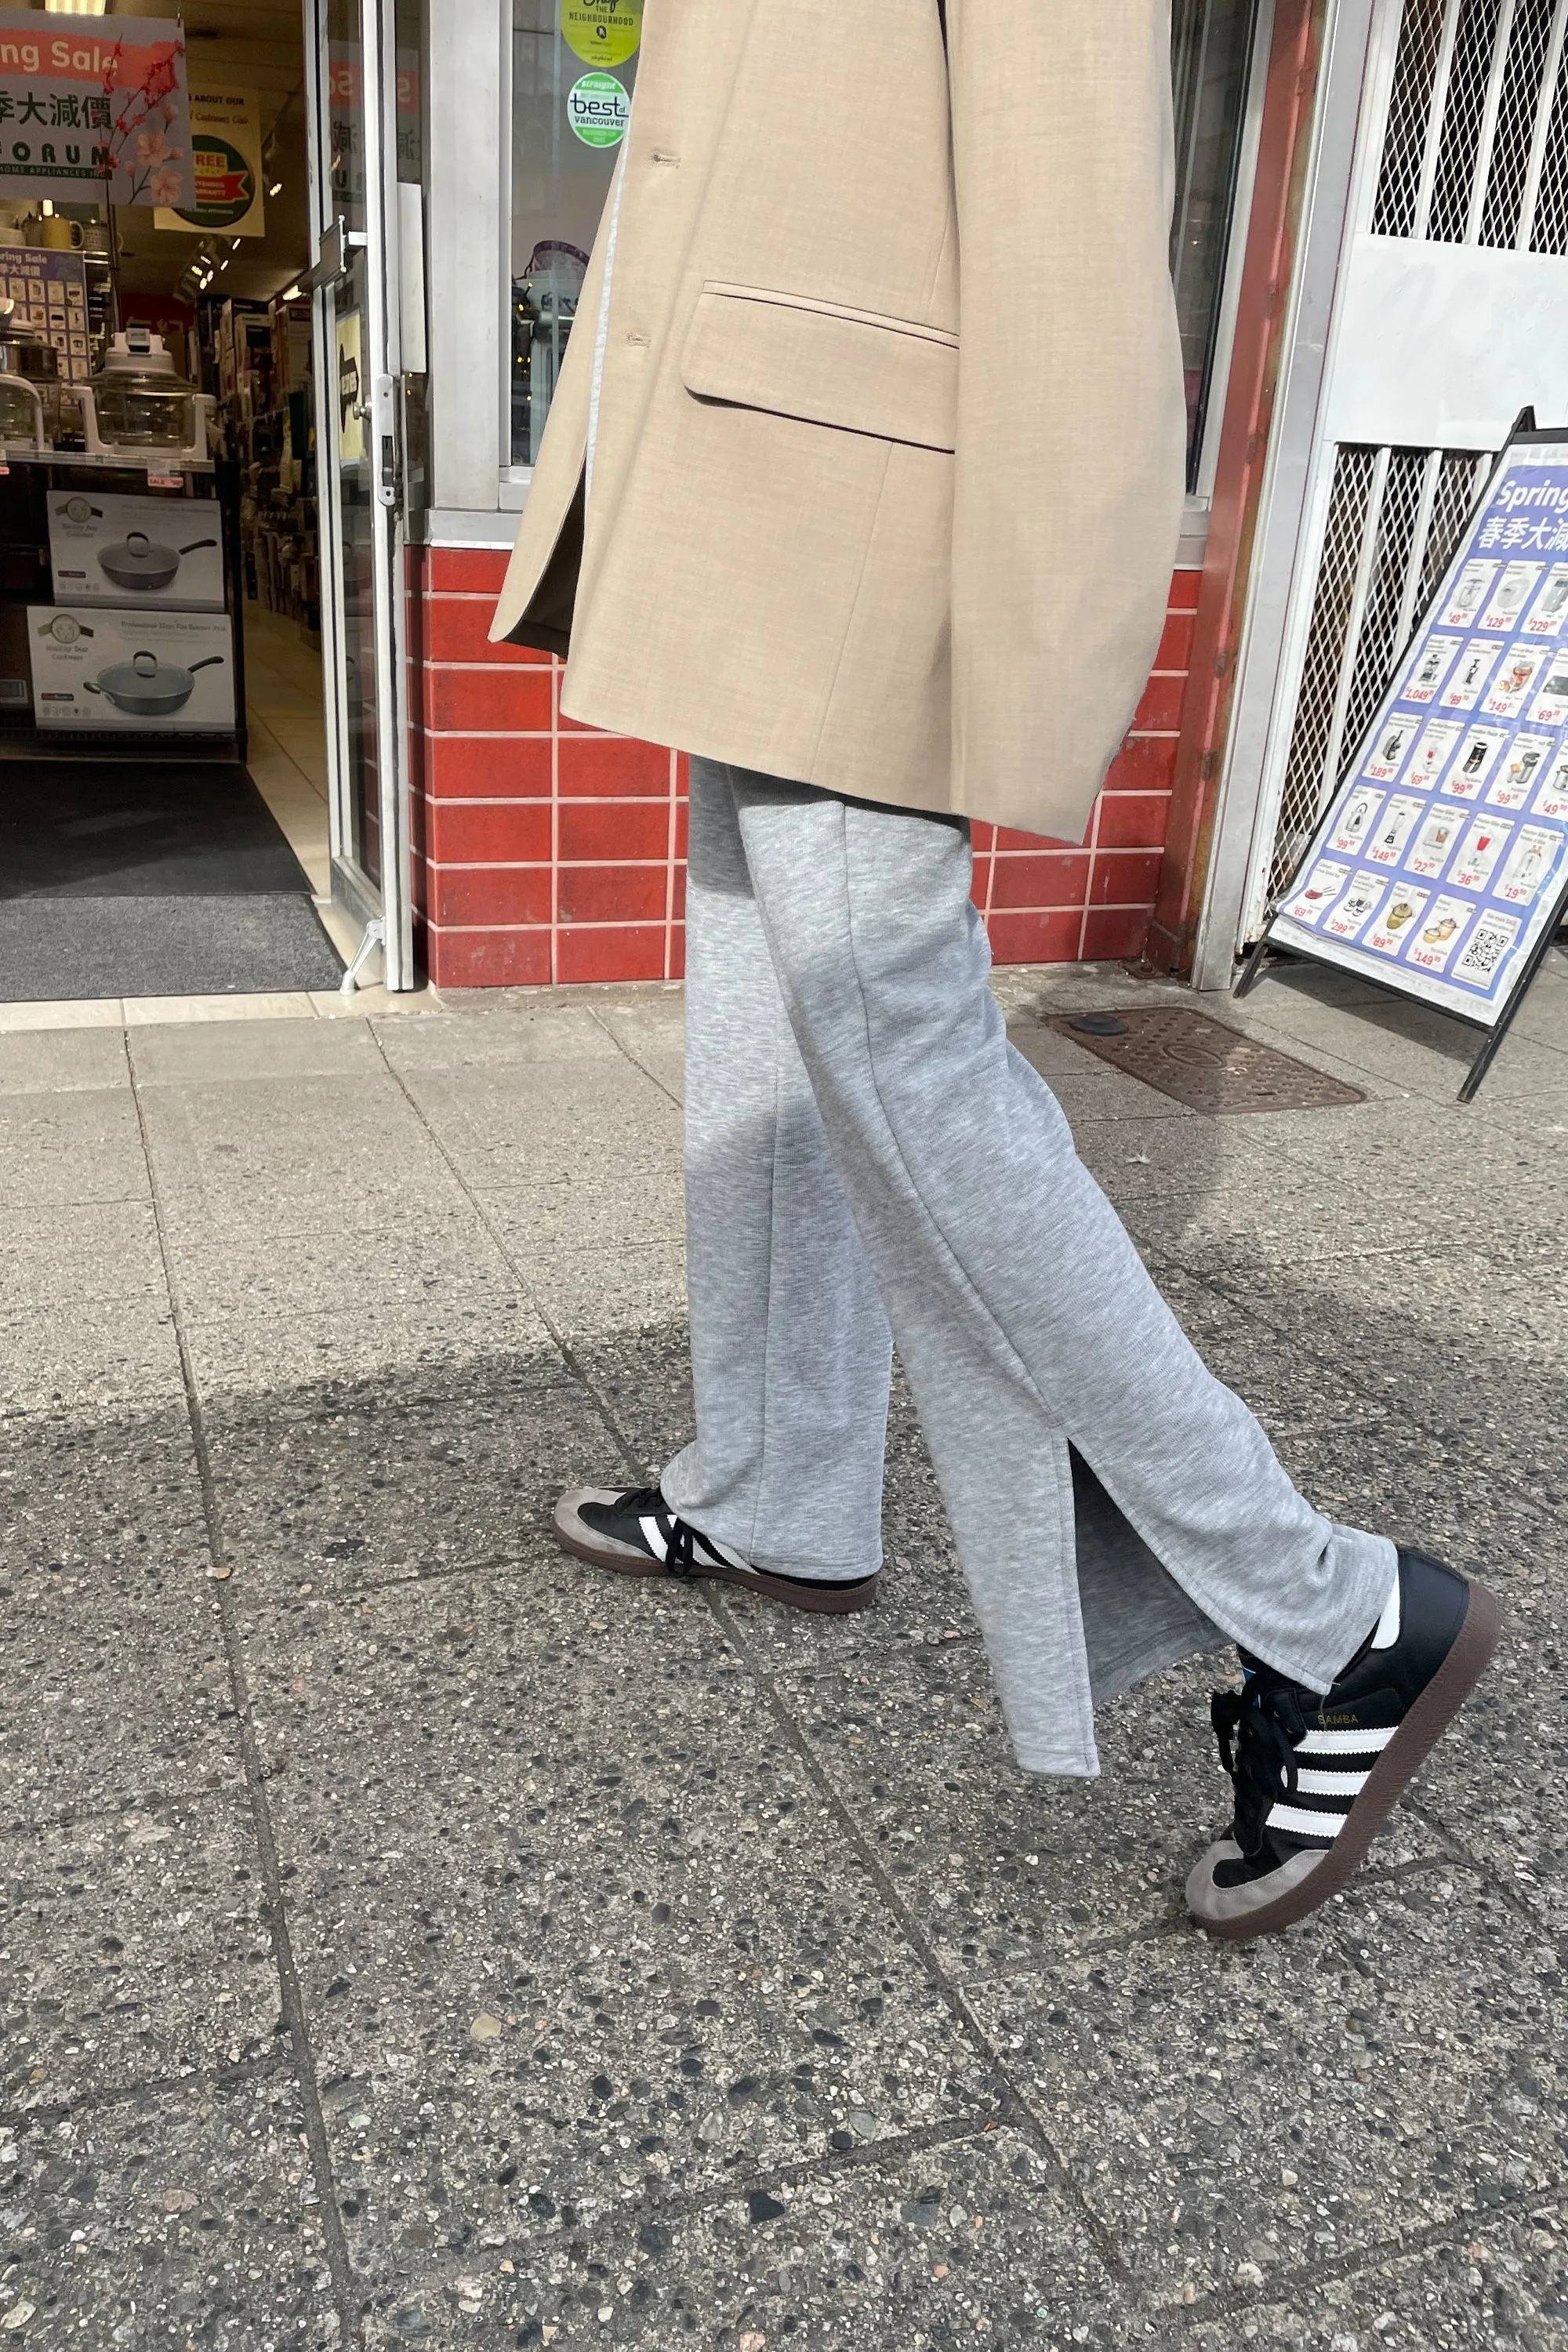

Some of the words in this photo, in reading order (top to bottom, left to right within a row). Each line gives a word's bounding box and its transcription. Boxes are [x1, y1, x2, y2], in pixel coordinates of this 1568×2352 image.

[568, 12, 633, 26] NEIGHBOURHOOD
[51, 41, 118, 76] Sale
[194, 95, 223, 105] ABOUT
[570, 93, 629, 118] best
[575, 115, 625, 126] vancouver
[1496, 479, 1568, 514] Spring
[1317, 1714, 1359, 1725] SAMBA
